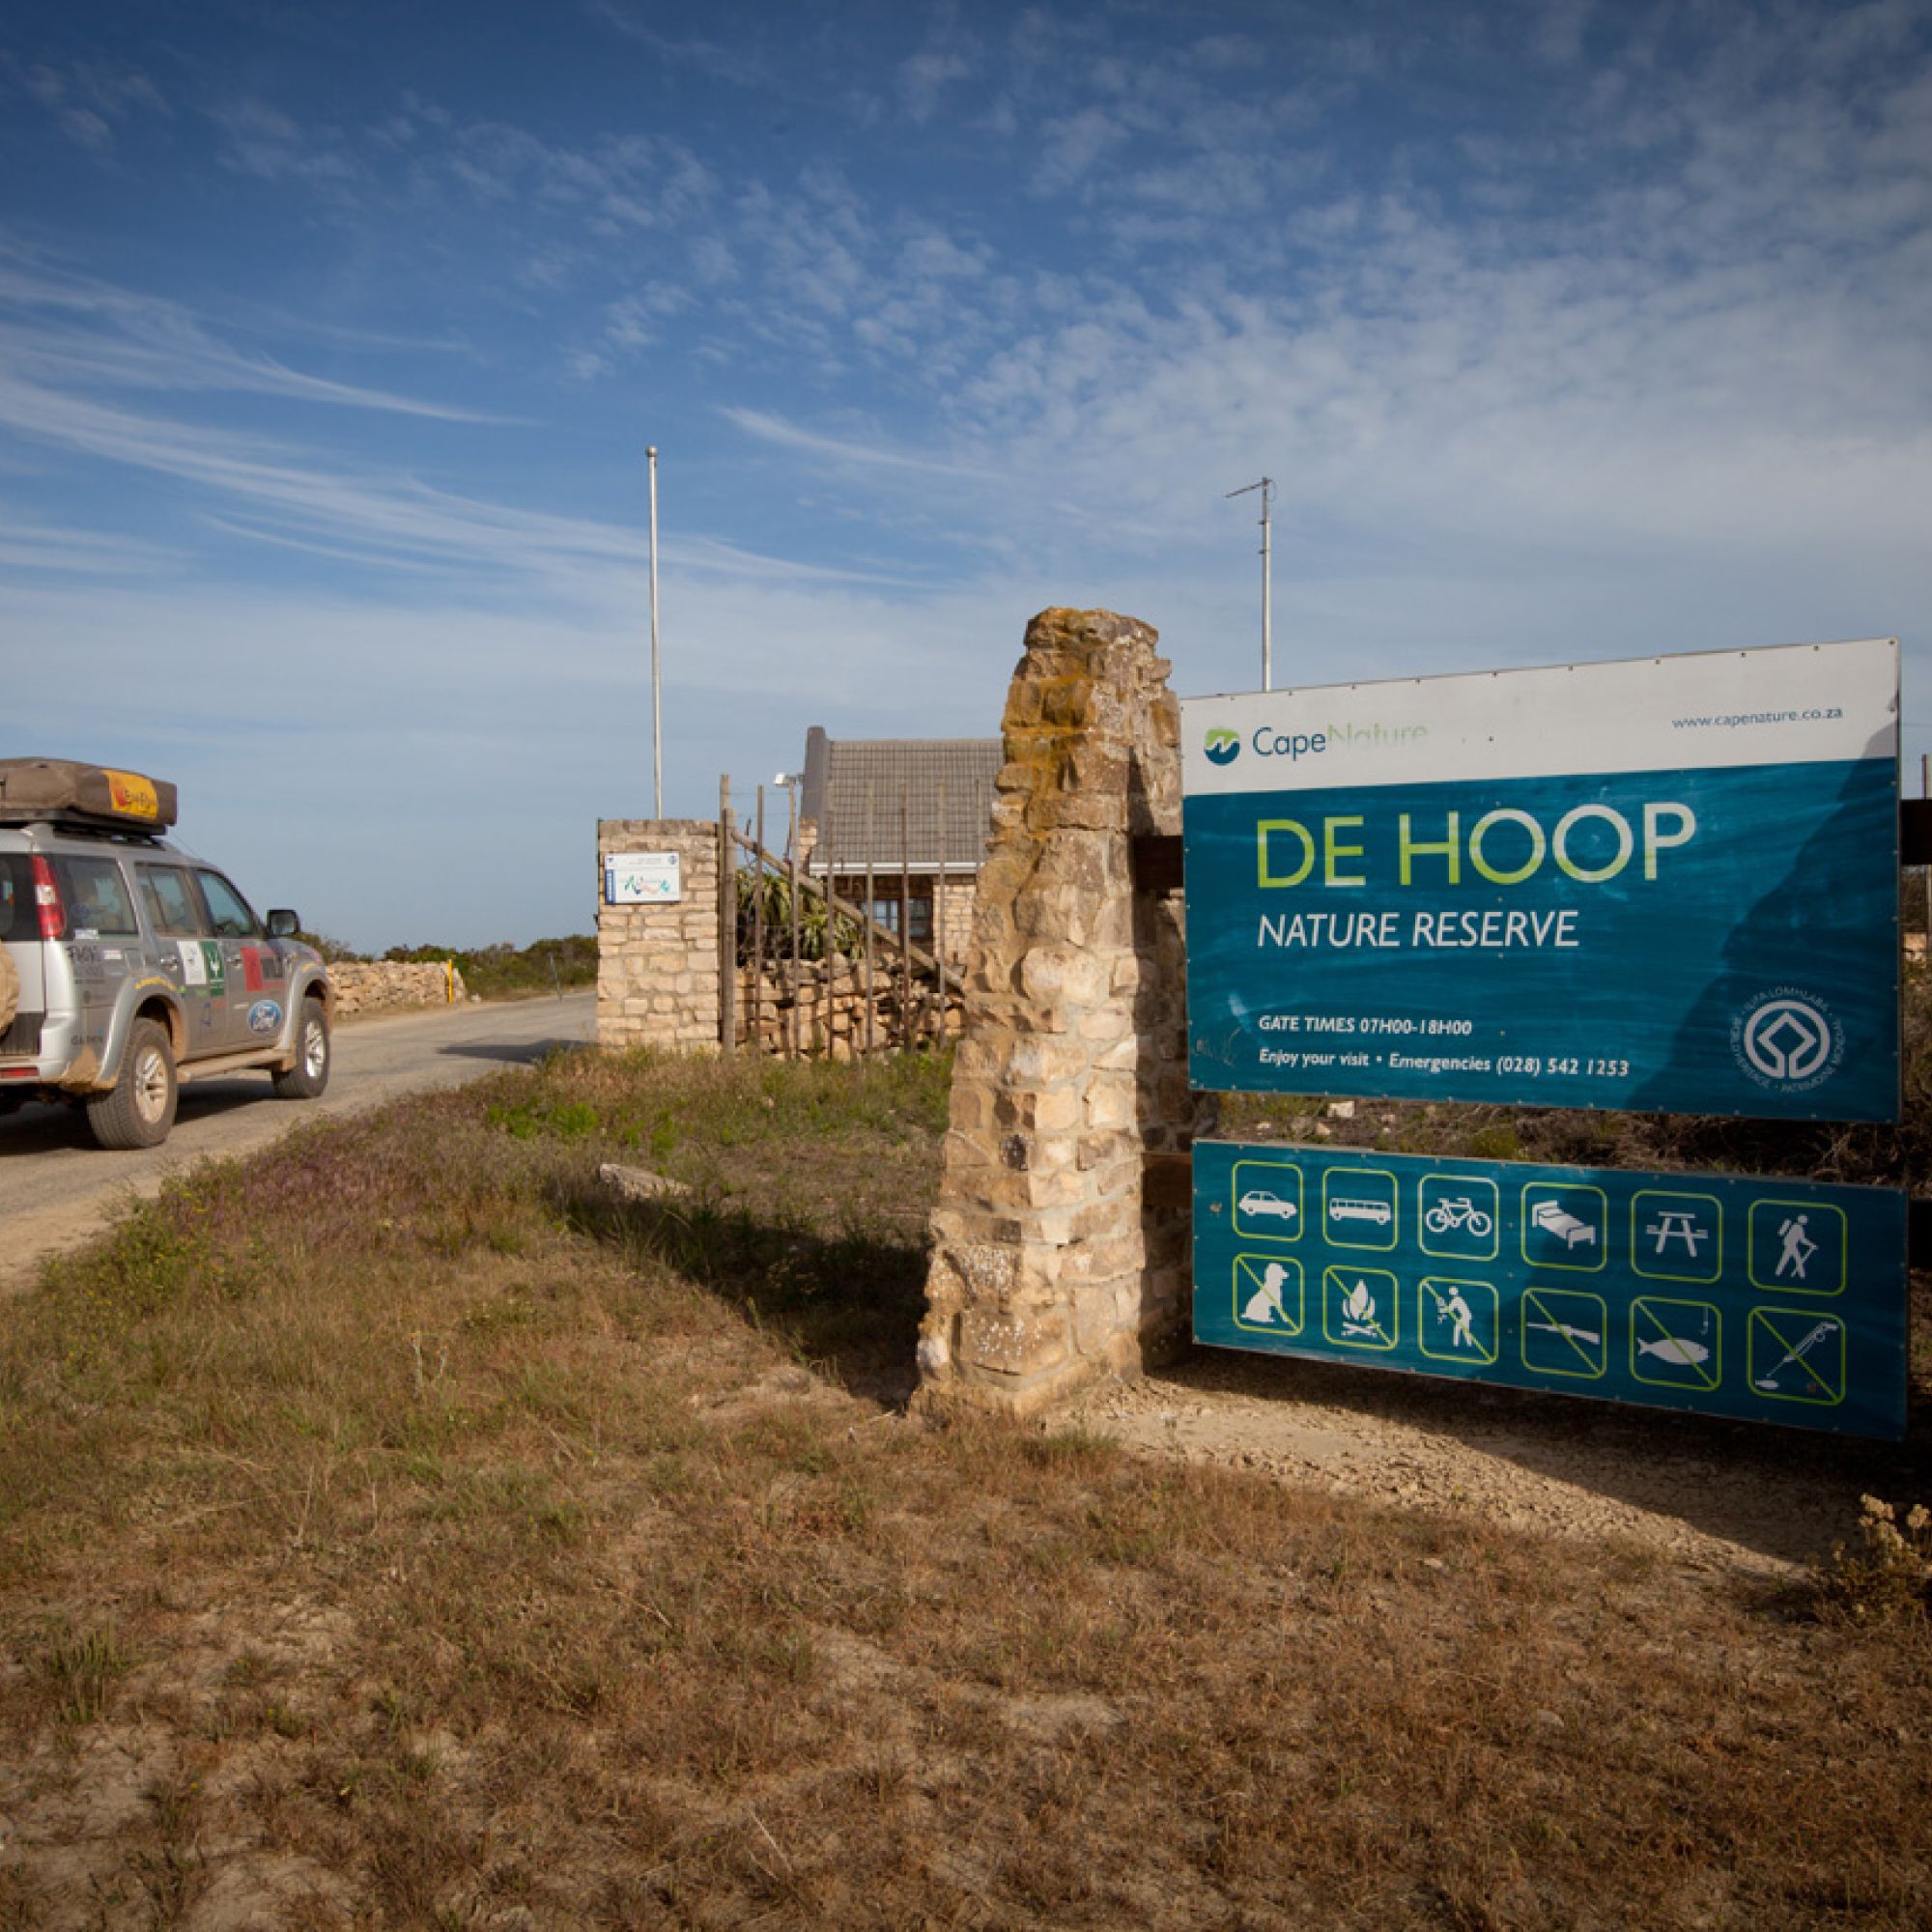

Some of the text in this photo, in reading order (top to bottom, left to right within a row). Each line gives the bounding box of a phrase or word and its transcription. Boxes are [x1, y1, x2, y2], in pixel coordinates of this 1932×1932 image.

[1671, 707, 1843, 727] www.capenature.co.za
[1258, 802, 1697, 888] DE HOOP
[1258, 910, 1580, 949] NATURE RESERVE
[1259, 1015, 1472, 1036] GATE TIMES 07H00-18H00
[1259, 1047, 1631, 1077] Enjoy your visit Emergencies (028) 542 1253
